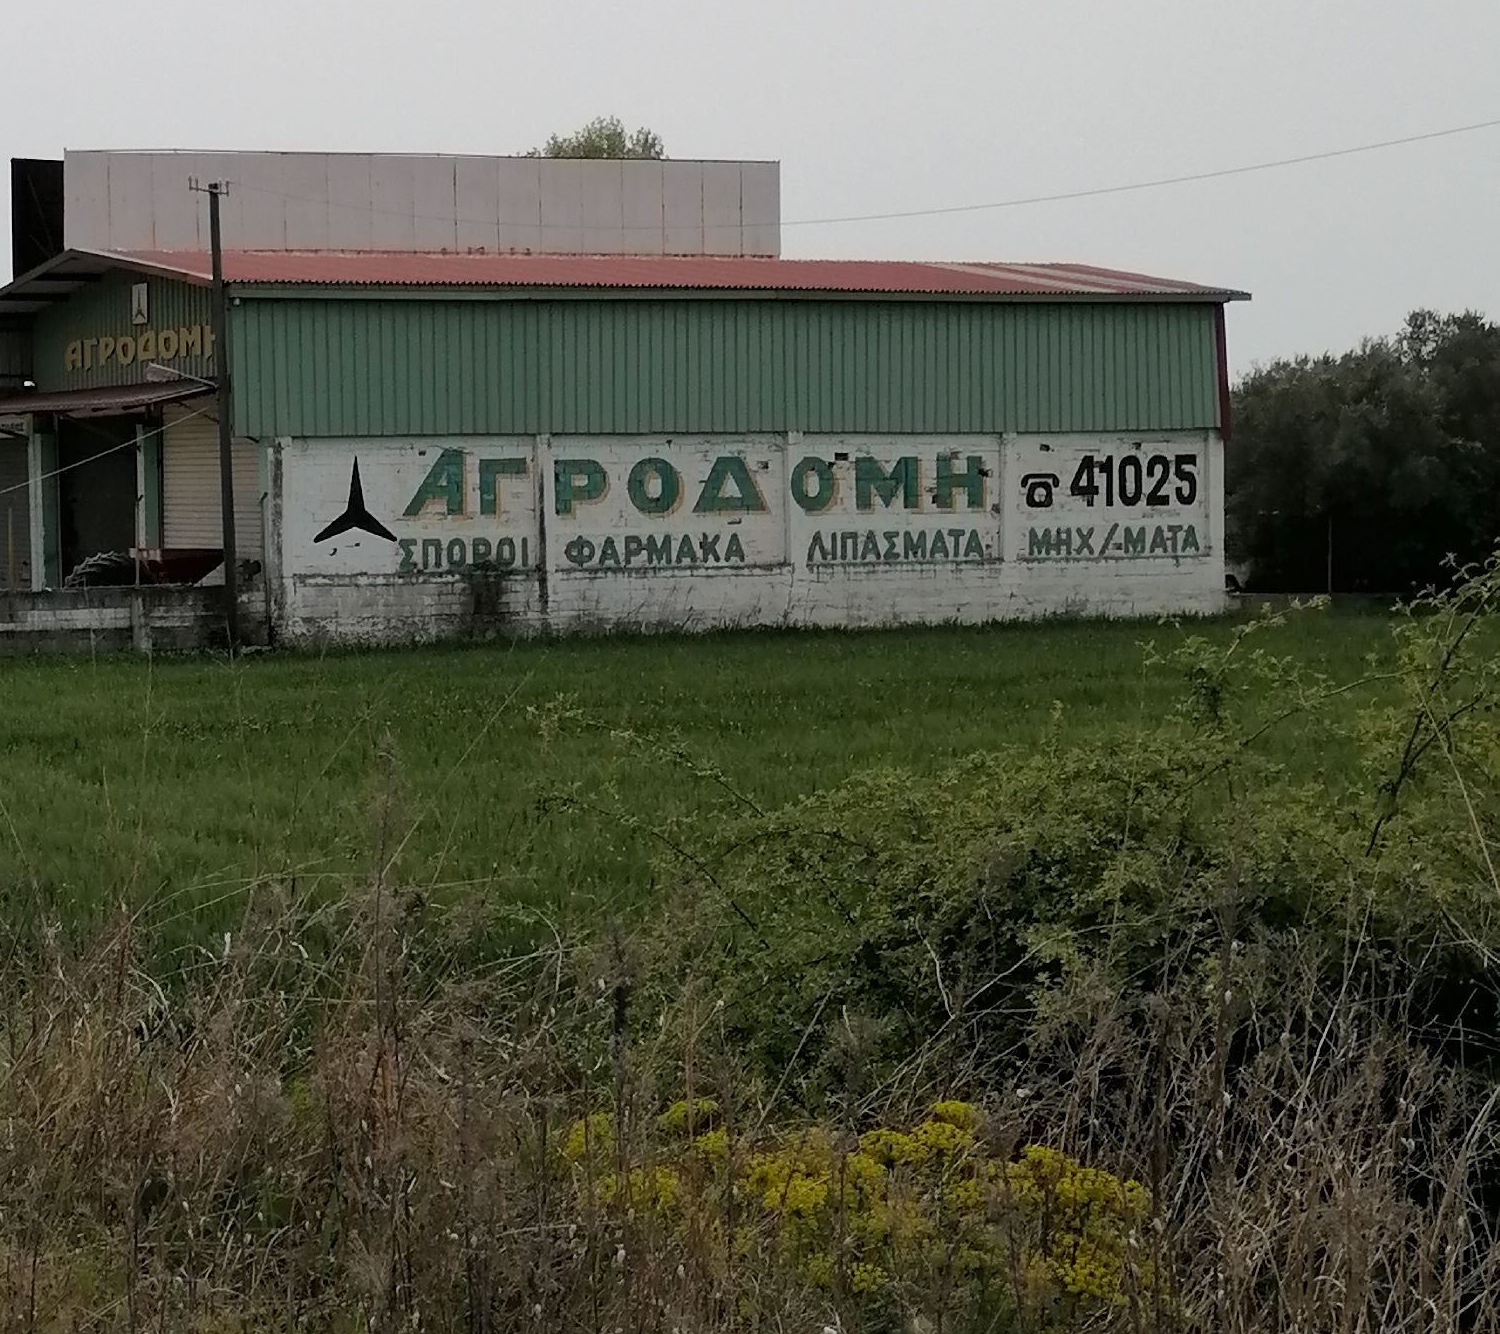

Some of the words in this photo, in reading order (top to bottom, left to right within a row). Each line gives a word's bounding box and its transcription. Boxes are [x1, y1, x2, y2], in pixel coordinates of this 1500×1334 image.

[402, 447, 987, 517] ΑΓΡΟΔΟΜΗ
[1069, 454, 1198, 507] 41025
[400, 536, 529, 568] ΣΠΟΡΟΙ
[564, 532, 746, 567] ΦΑΡΜΑΚΑ
[806, 528, 986, 563] ΛΙΠΑΣΜΑΤΑ
